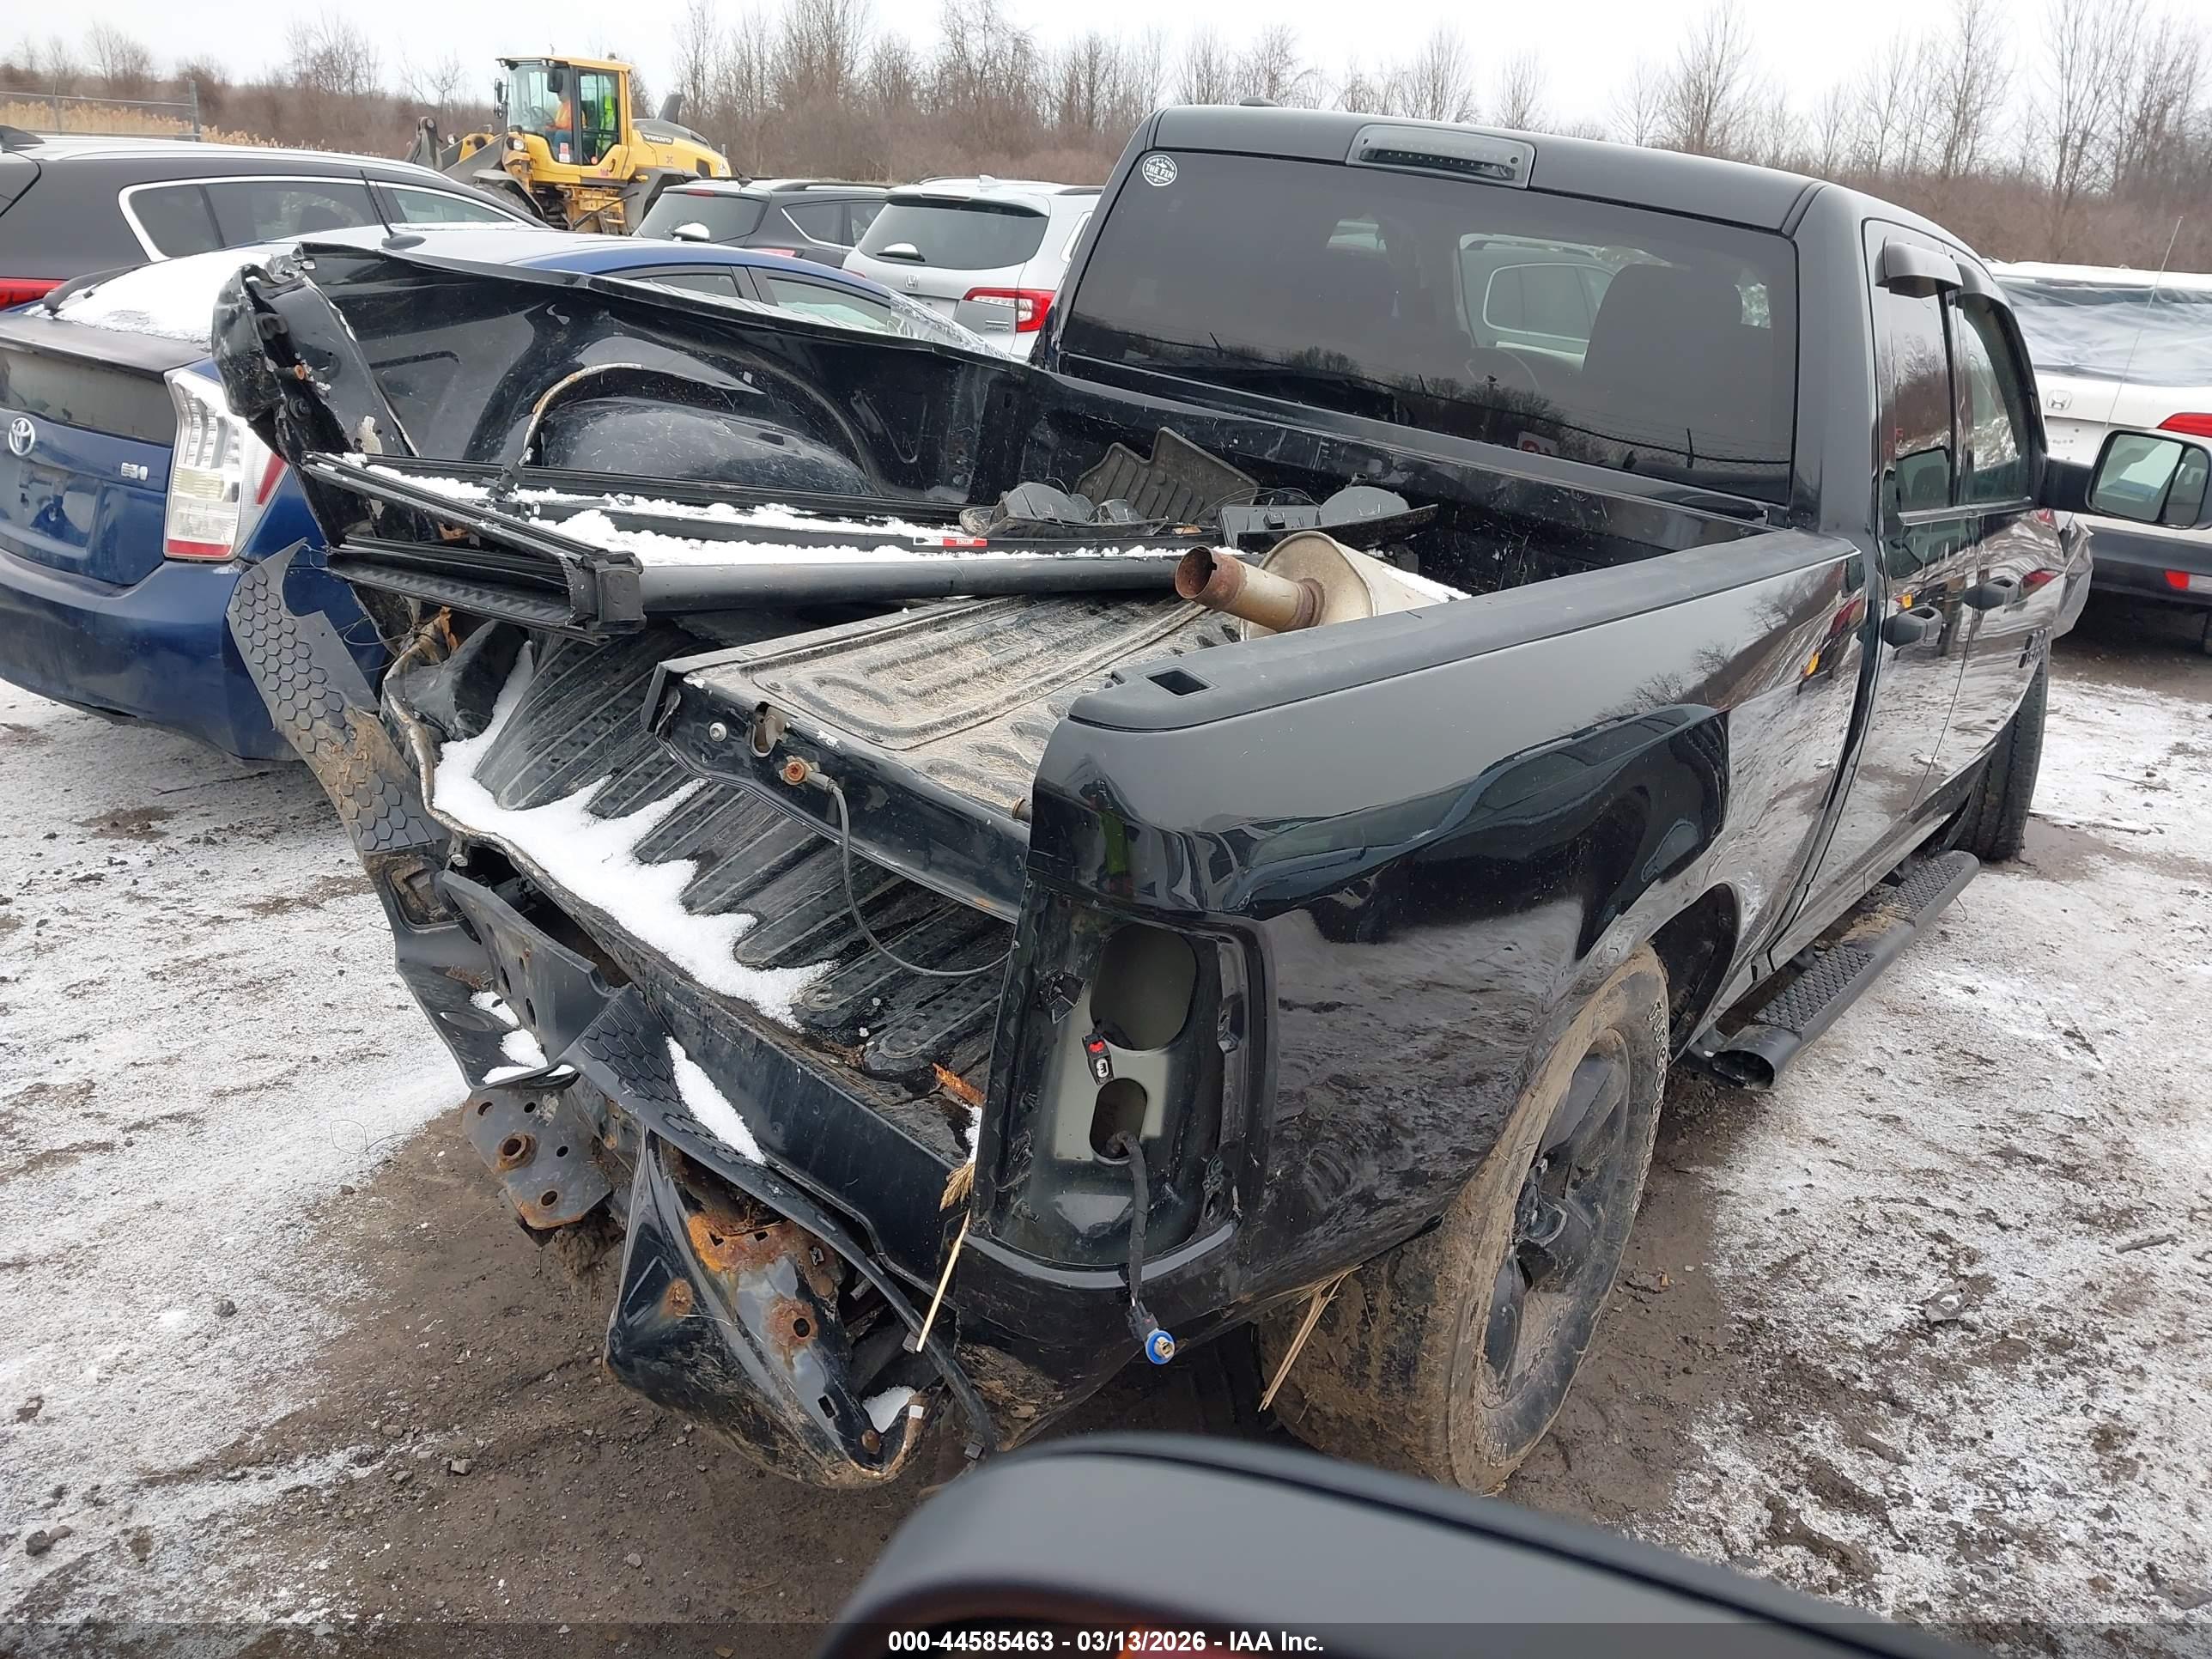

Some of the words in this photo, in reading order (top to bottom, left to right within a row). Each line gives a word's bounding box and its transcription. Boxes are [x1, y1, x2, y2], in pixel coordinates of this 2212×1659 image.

[643, 134, 672, 143] VOLVO
[1146, 163, 1160, 175] THE
[1159, 168, 1175, 179] FIN
